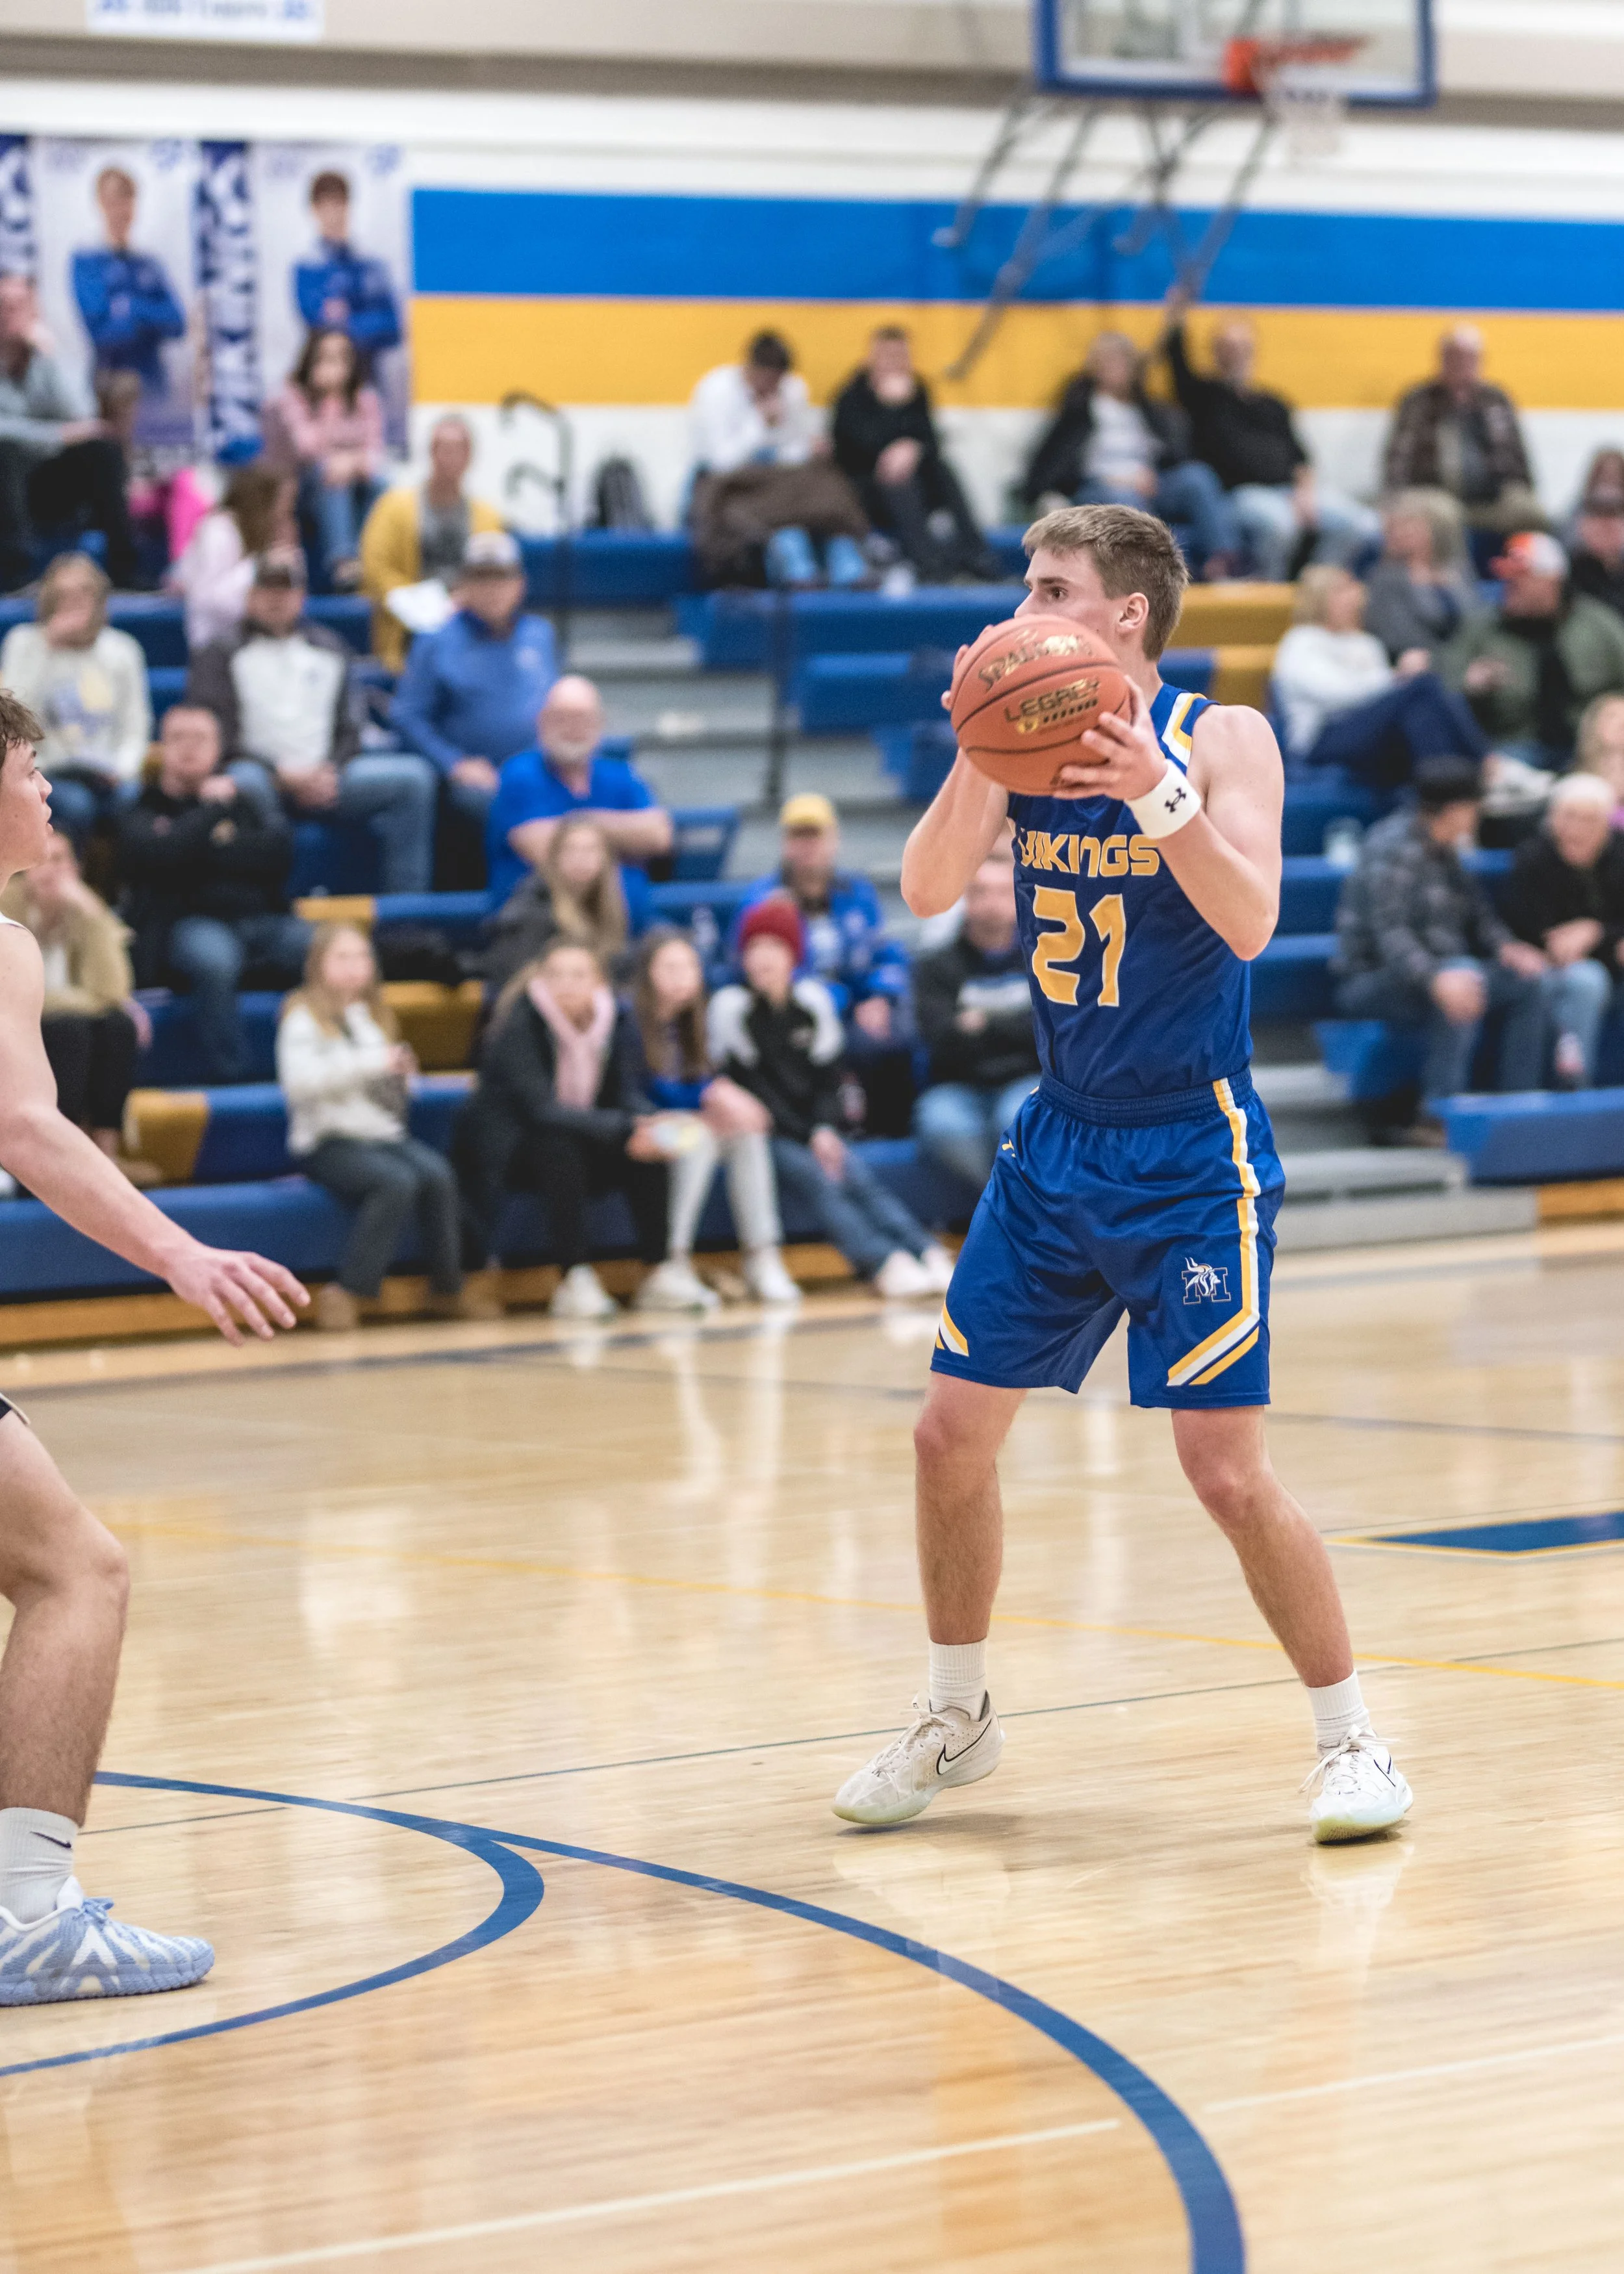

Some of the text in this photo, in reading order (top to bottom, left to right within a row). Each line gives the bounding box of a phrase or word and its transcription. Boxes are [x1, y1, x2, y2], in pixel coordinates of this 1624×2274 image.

[1004, 678, 1100, 722] LEGACY
[1018, 827, 1160, 878] VIKINGS
[1032, 884, 1126, 1007] 21
